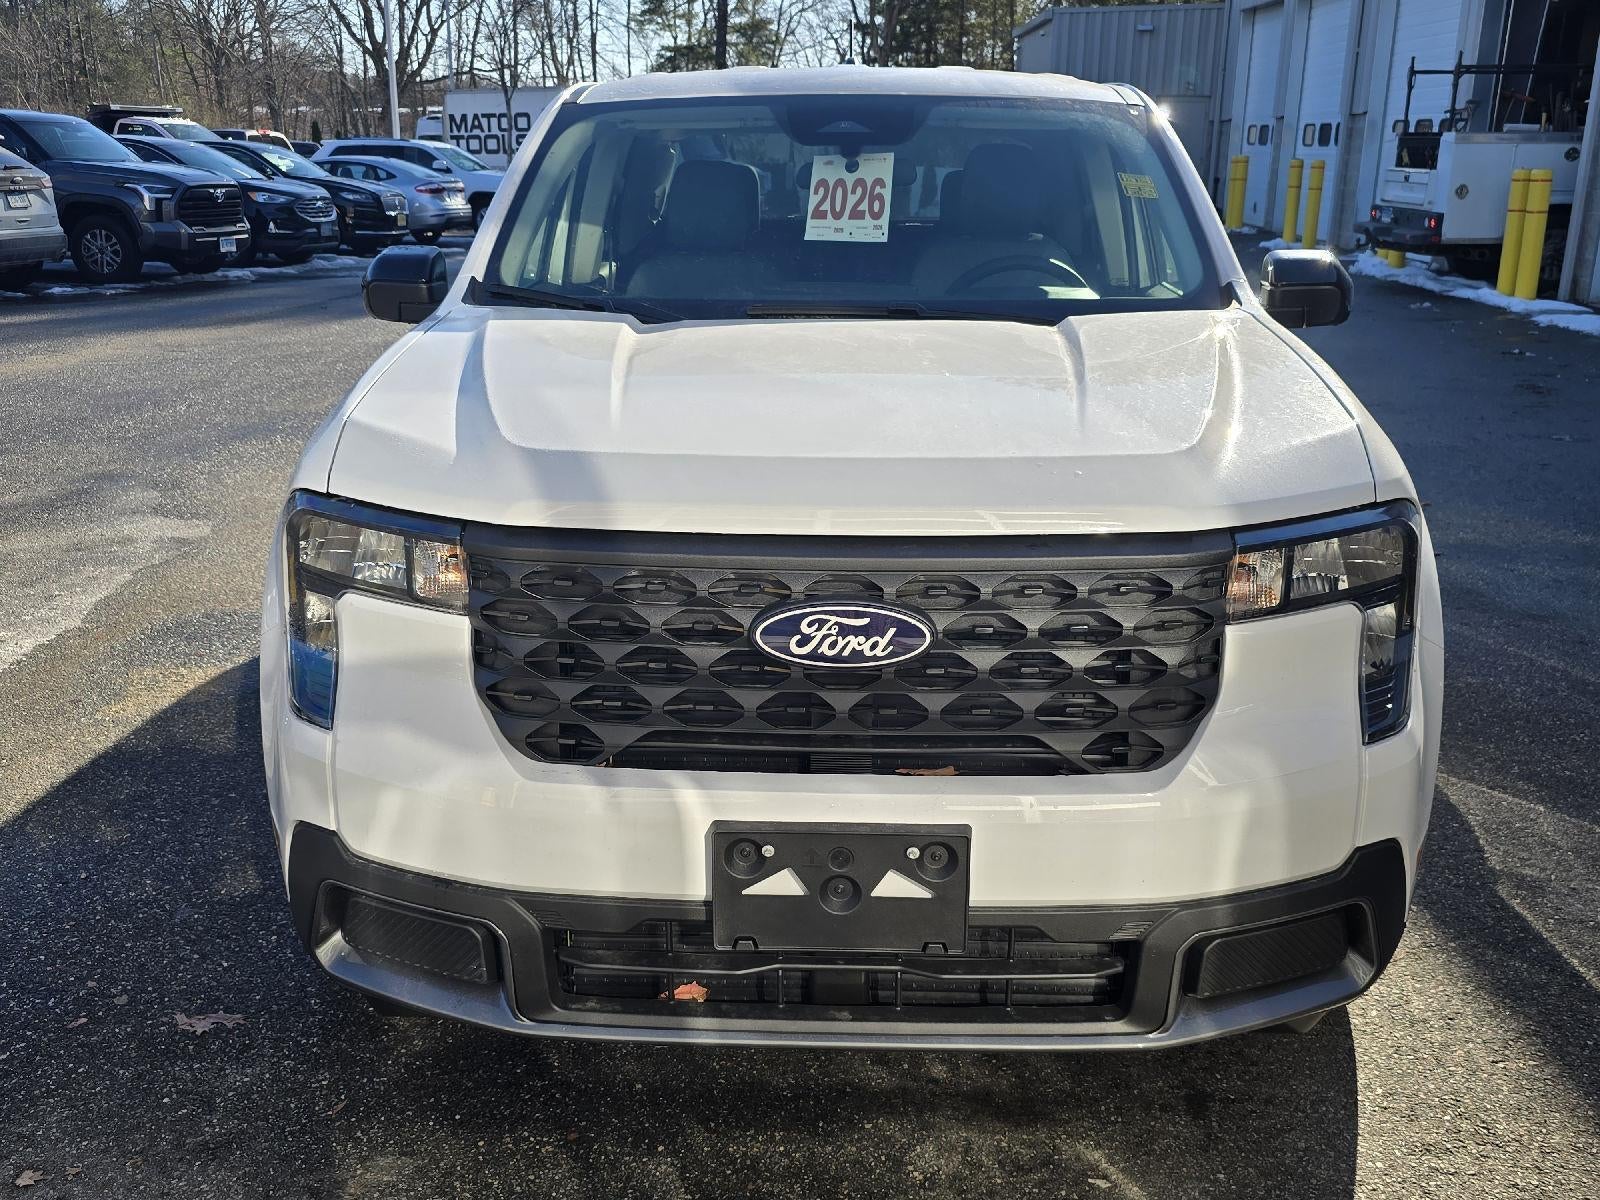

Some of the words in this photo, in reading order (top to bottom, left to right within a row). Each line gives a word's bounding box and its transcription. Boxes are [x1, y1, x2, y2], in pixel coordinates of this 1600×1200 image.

[448, 112, 531, 133] MATCO
[810, 177, 887, 221] 2026
[789, 614, 897, 656] Ford
